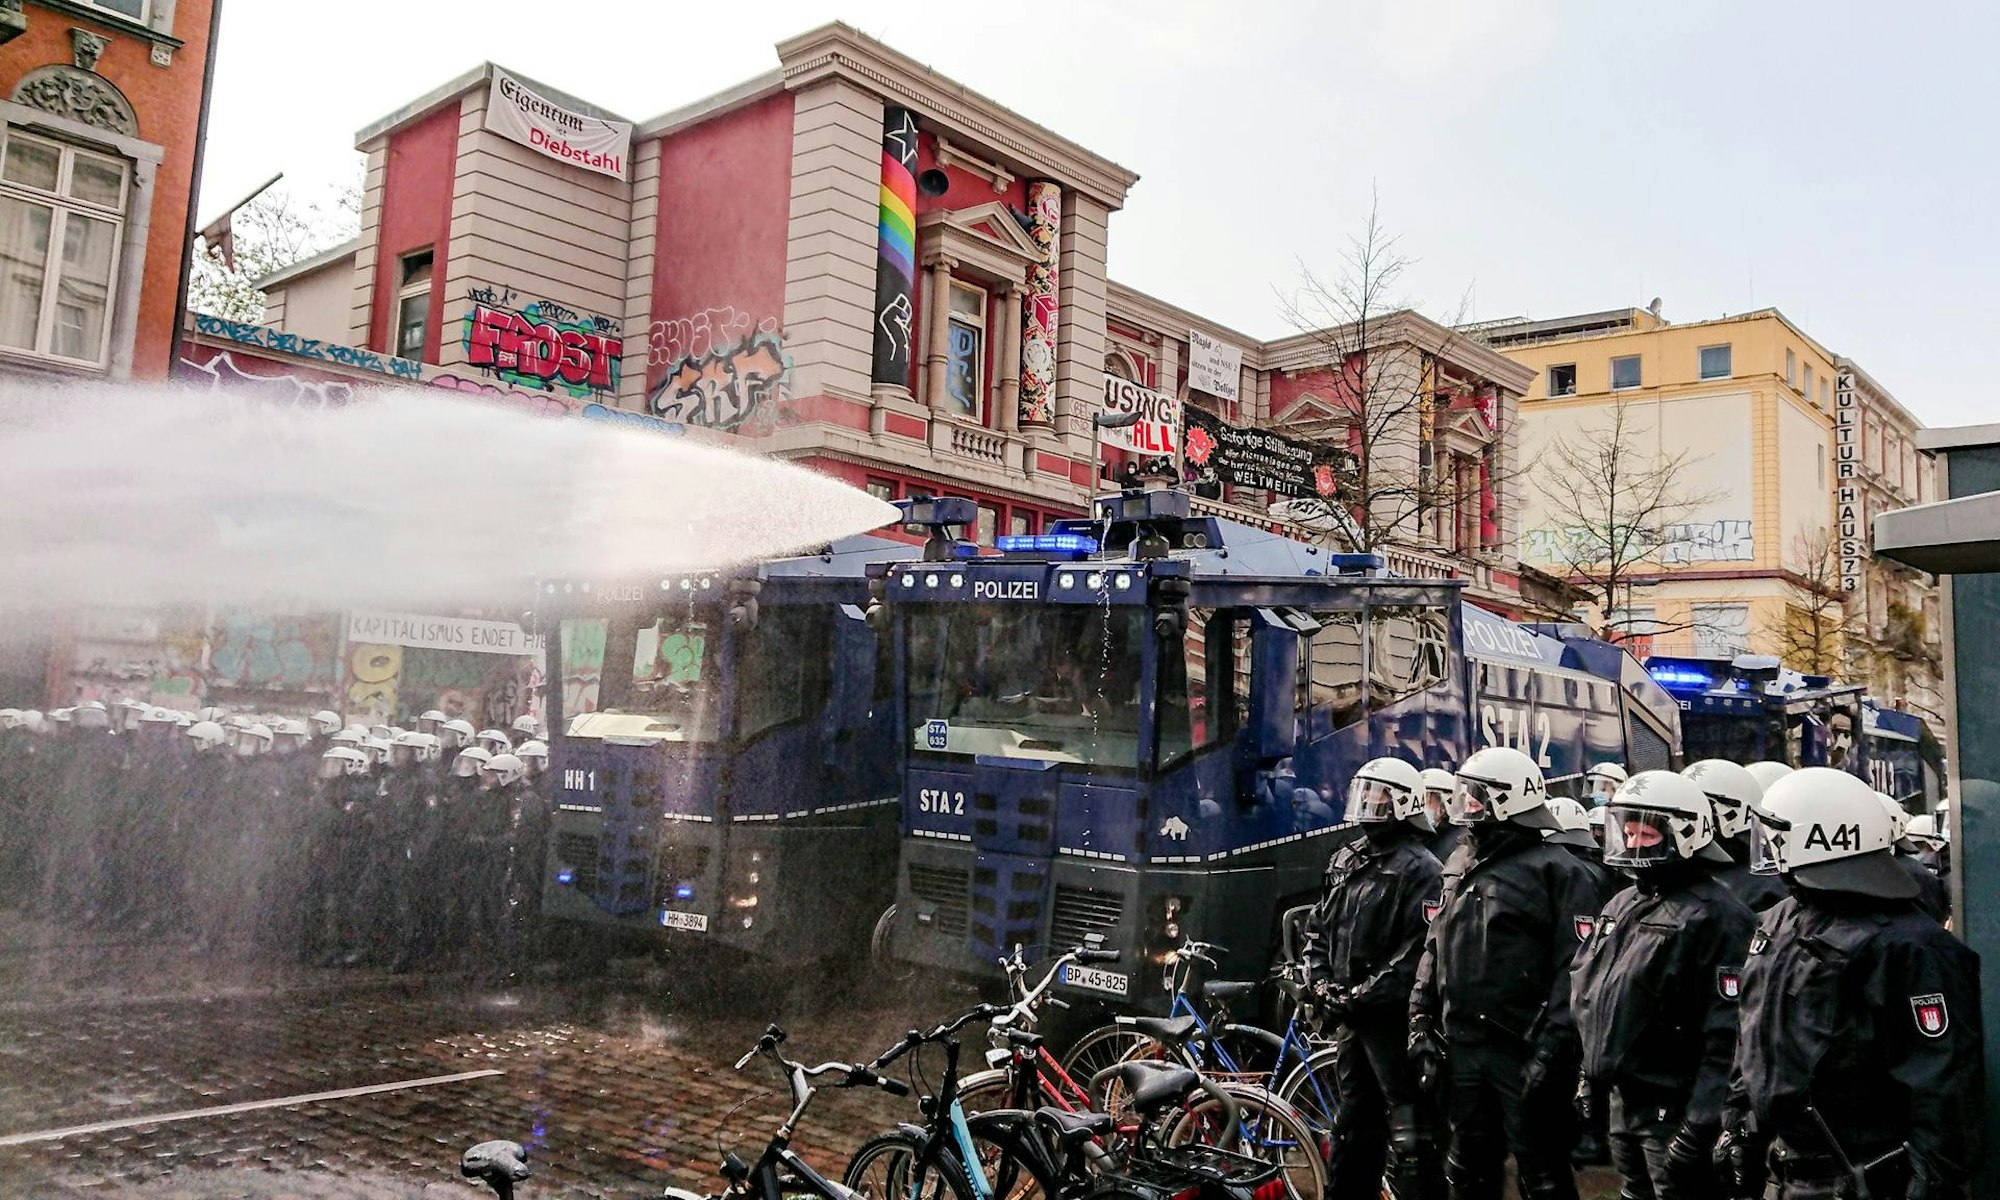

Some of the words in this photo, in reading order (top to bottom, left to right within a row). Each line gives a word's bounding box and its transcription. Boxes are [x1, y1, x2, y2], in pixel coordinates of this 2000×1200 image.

[500, 77, 583, 131] Eigentum
[529, 127, 621, 173] Diebstahl
[1133, 420, 1175, 453] ALL
[1837, 376, 1853, 478] KULTUR
[975, 580, 1039, 599] POLIZEI
[353, 616, 464, 643] KAPITALISMUS
[472, 626, 516, 647] ENDET
[1463, 618, 1543, 660] POLIZEI
[928, 724, 946, 734] STA
[1482, 704, 1531, 757] STA
[1538, 712, 1551, 768] 2
[565, 769, 584, 790] HH
[588, 771, 595, 791] 1
[920, 788, 950, 814] STA
[954, 792, 964, 815] 2
[1804, 823, 1861, 851] A41
[1067, 967, 1081, 981] BP
[1088, 972, 1126, 991] 45-825
